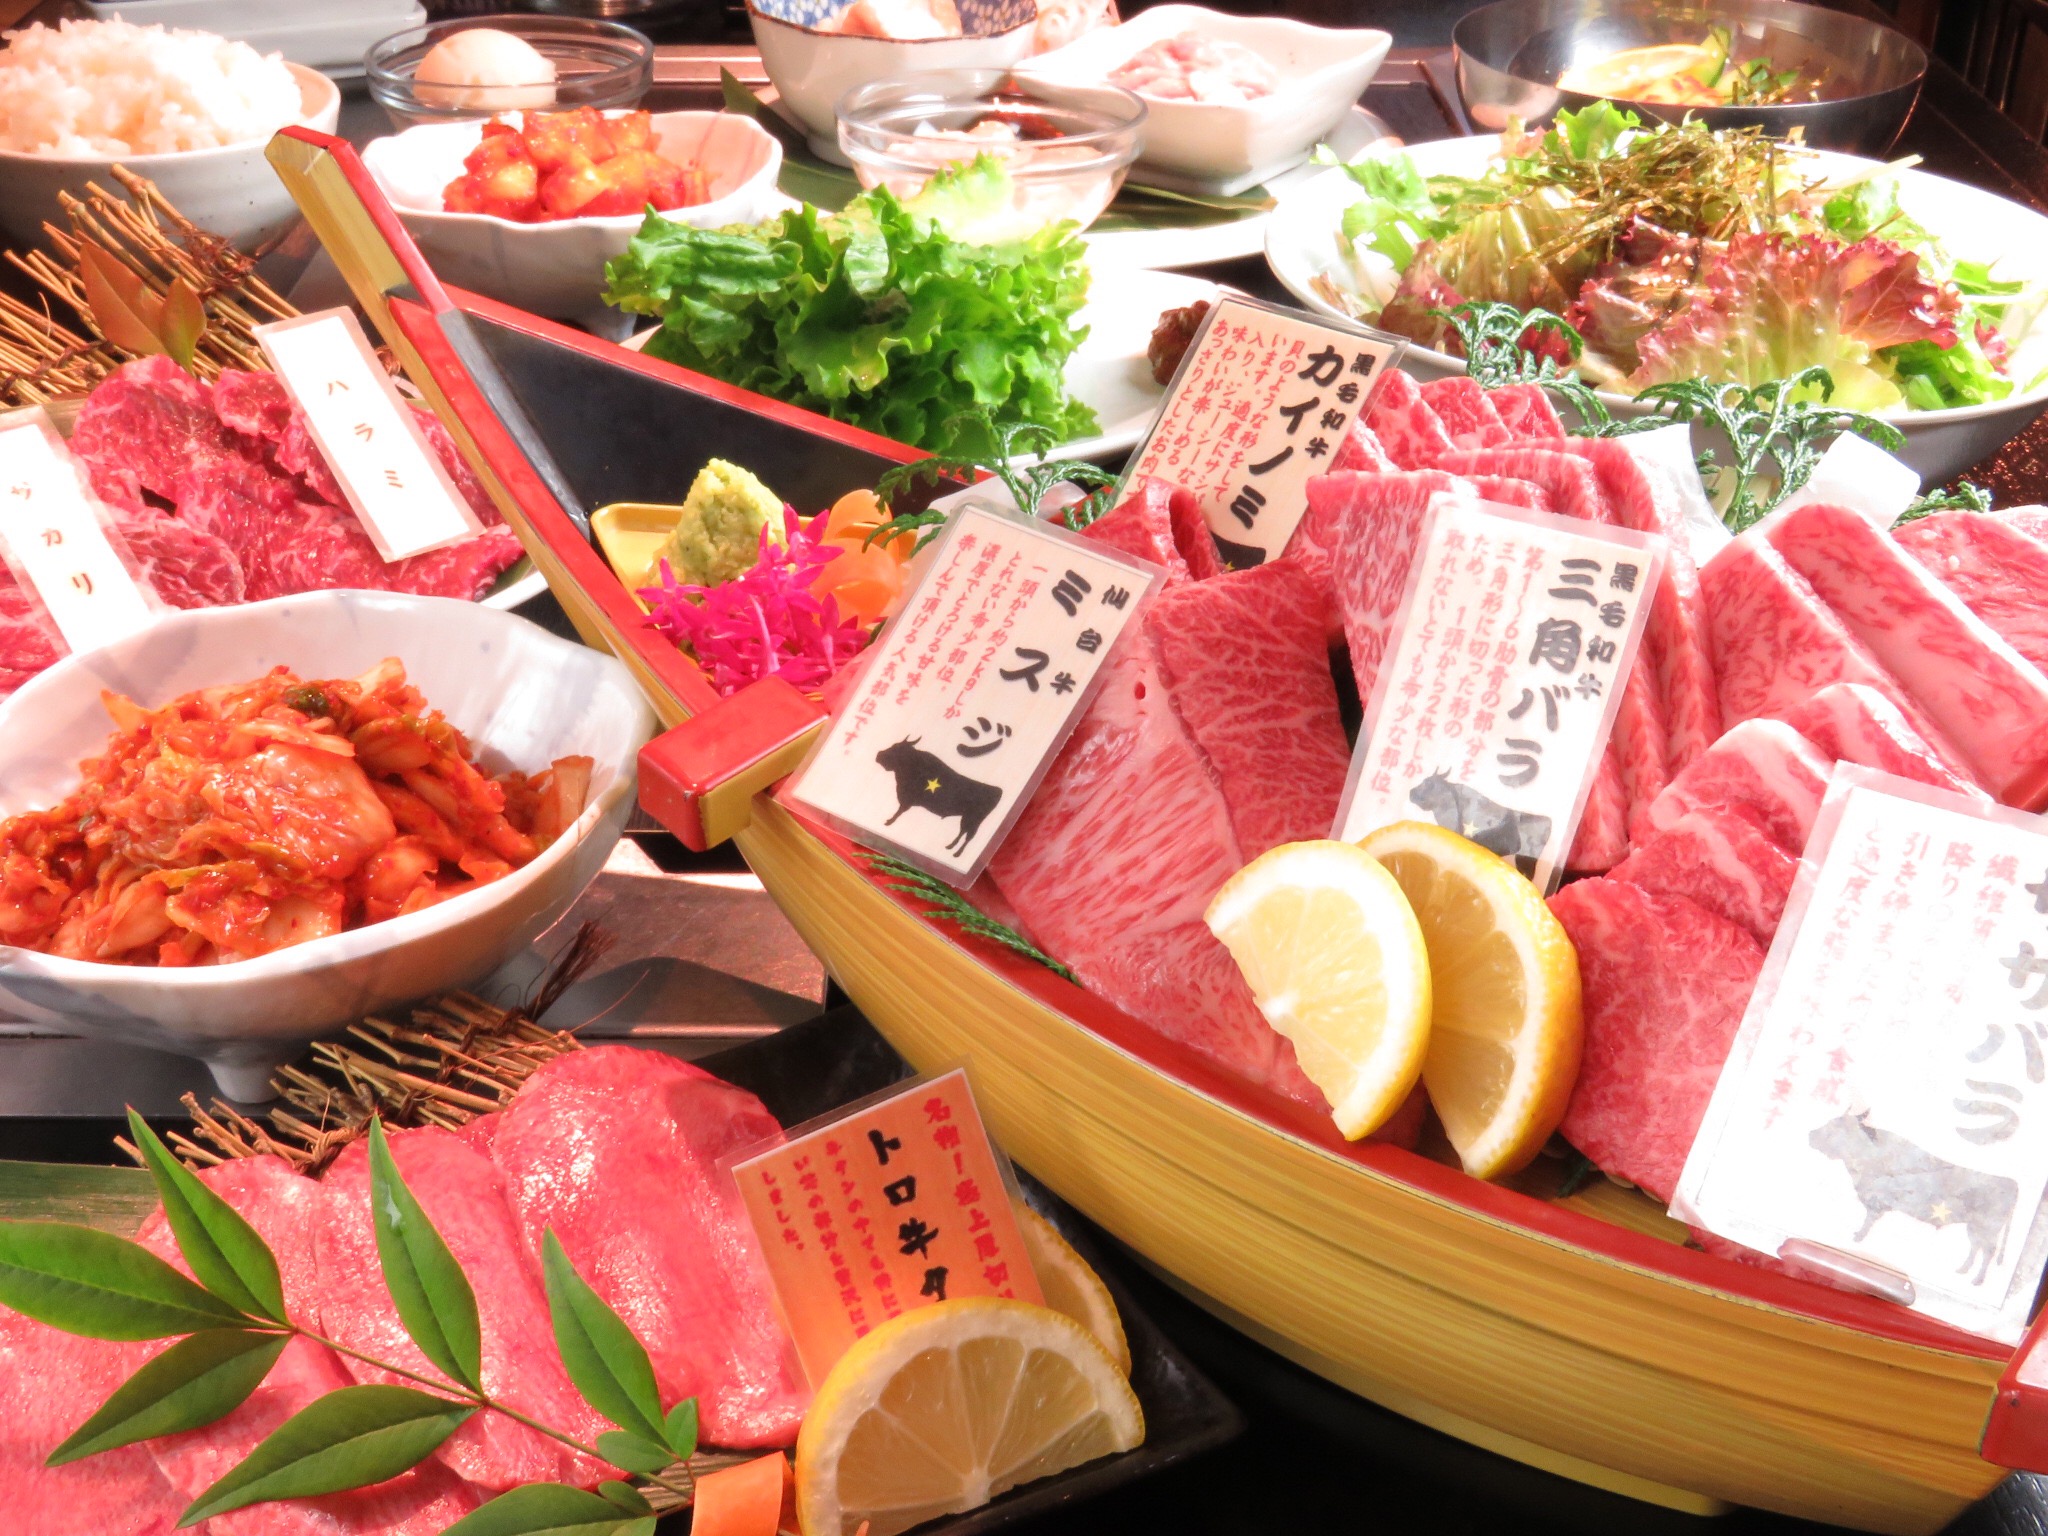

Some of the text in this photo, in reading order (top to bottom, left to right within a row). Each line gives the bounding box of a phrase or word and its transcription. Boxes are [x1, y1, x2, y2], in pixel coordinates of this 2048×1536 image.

[327, 380, 403, 489] ハラミ
[1167, 327, 1248, 466] 味わいが楽しめる
[1213, 340, 1305, 503] 貝のような形をして
[1230, 345, 1344, 530] カイノミ
[1304, 352, 1376, 458] 黒毛和牛
[843, 533, 978, 756] 楽しんで頂ける人気部位です。
[895, 542, 1002, 705] 濃厚でとろける甘味を
[956, 569, 1092, 758] ミスジ
[1049, 584, 1130, 695] 仙台牛
[1370, 529, 1465, 805] 取れないとても希少な部位。
[1444, 542, 1516, 738] 三角形に切った形の
[1496, 558, 1602, 789] 三角バラ
[1574, 562, 1638, 701] 黒毛和牛
